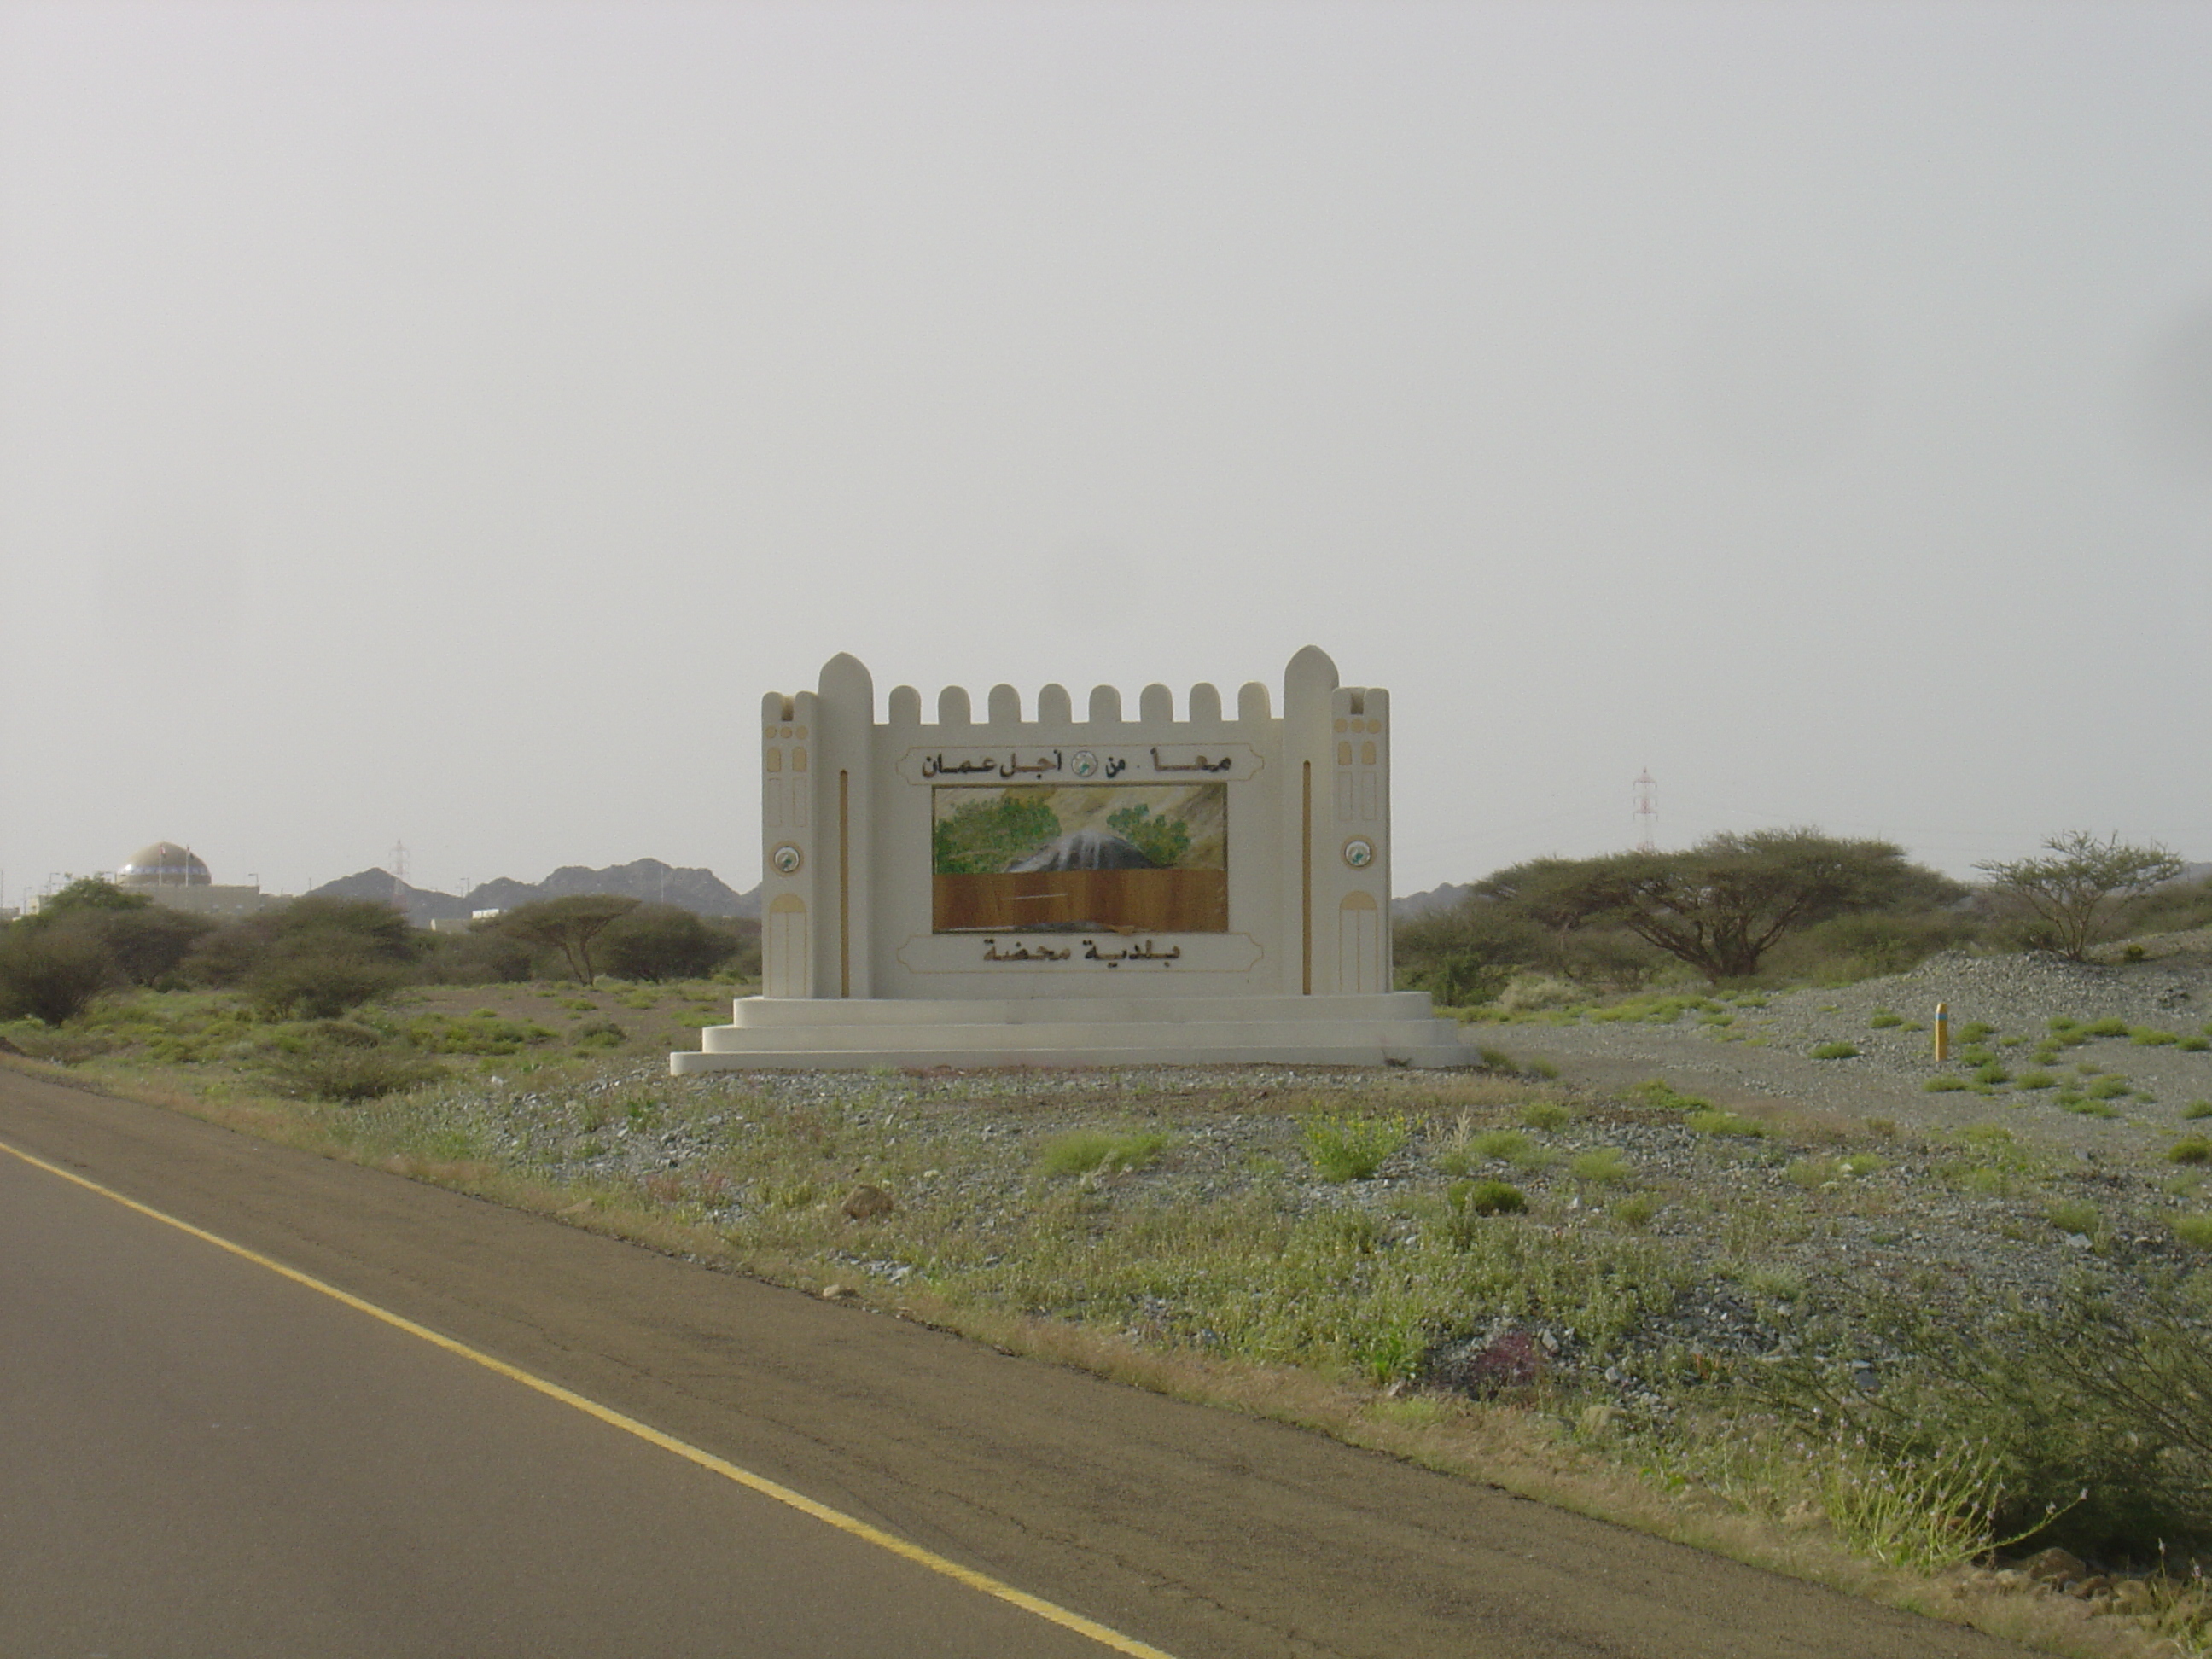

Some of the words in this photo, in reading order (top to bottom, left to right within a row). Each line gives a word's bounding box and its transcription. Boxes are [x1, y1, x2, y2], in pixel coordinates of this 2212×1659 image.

[922, 752, 997, 778] عمان
[1105, 756, 1126, 779] من
[983, 939, 1070, 961] محضة
[1083, 939, 1180, 968] بلدية
